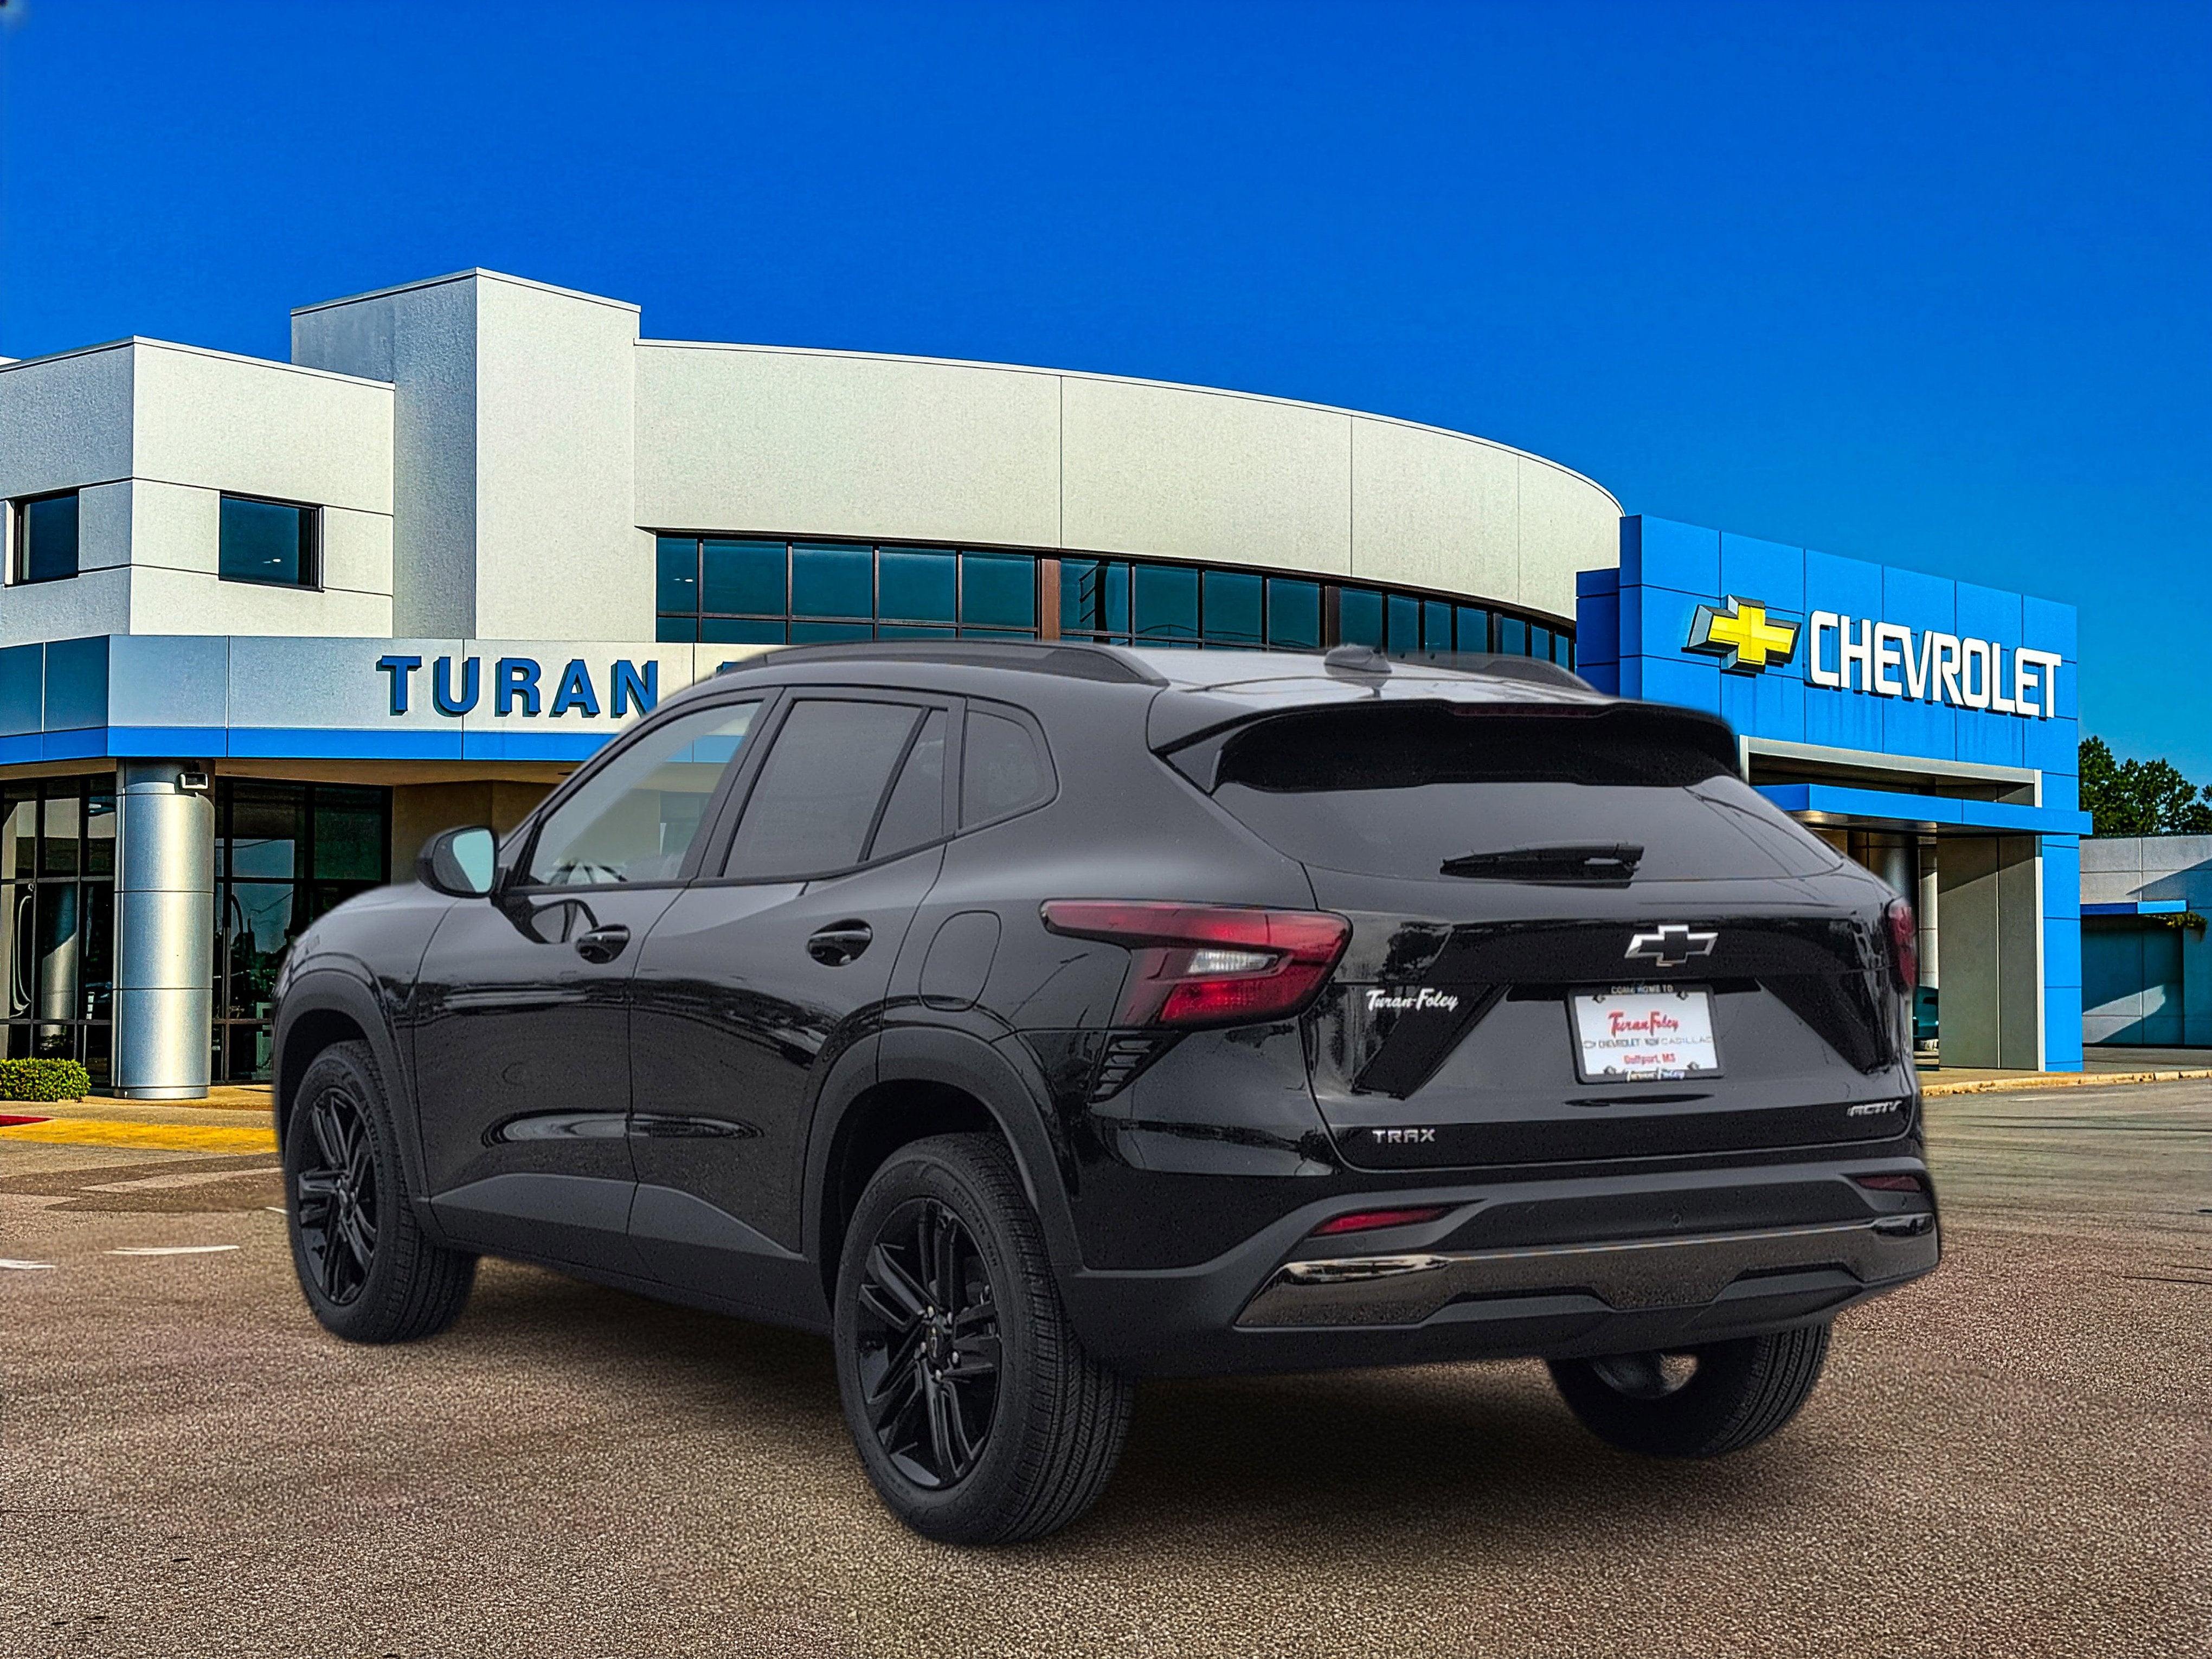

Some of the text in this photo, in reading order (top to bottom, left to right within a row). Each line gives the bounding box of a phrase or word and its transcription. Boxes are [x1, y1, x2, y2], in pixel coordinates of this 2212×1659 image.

[376, 654, 658, 718] TURAN
[1808, 609, 2062, 718] CHEVROLET
[1372, 1128, 1436, 1143] TRAX
